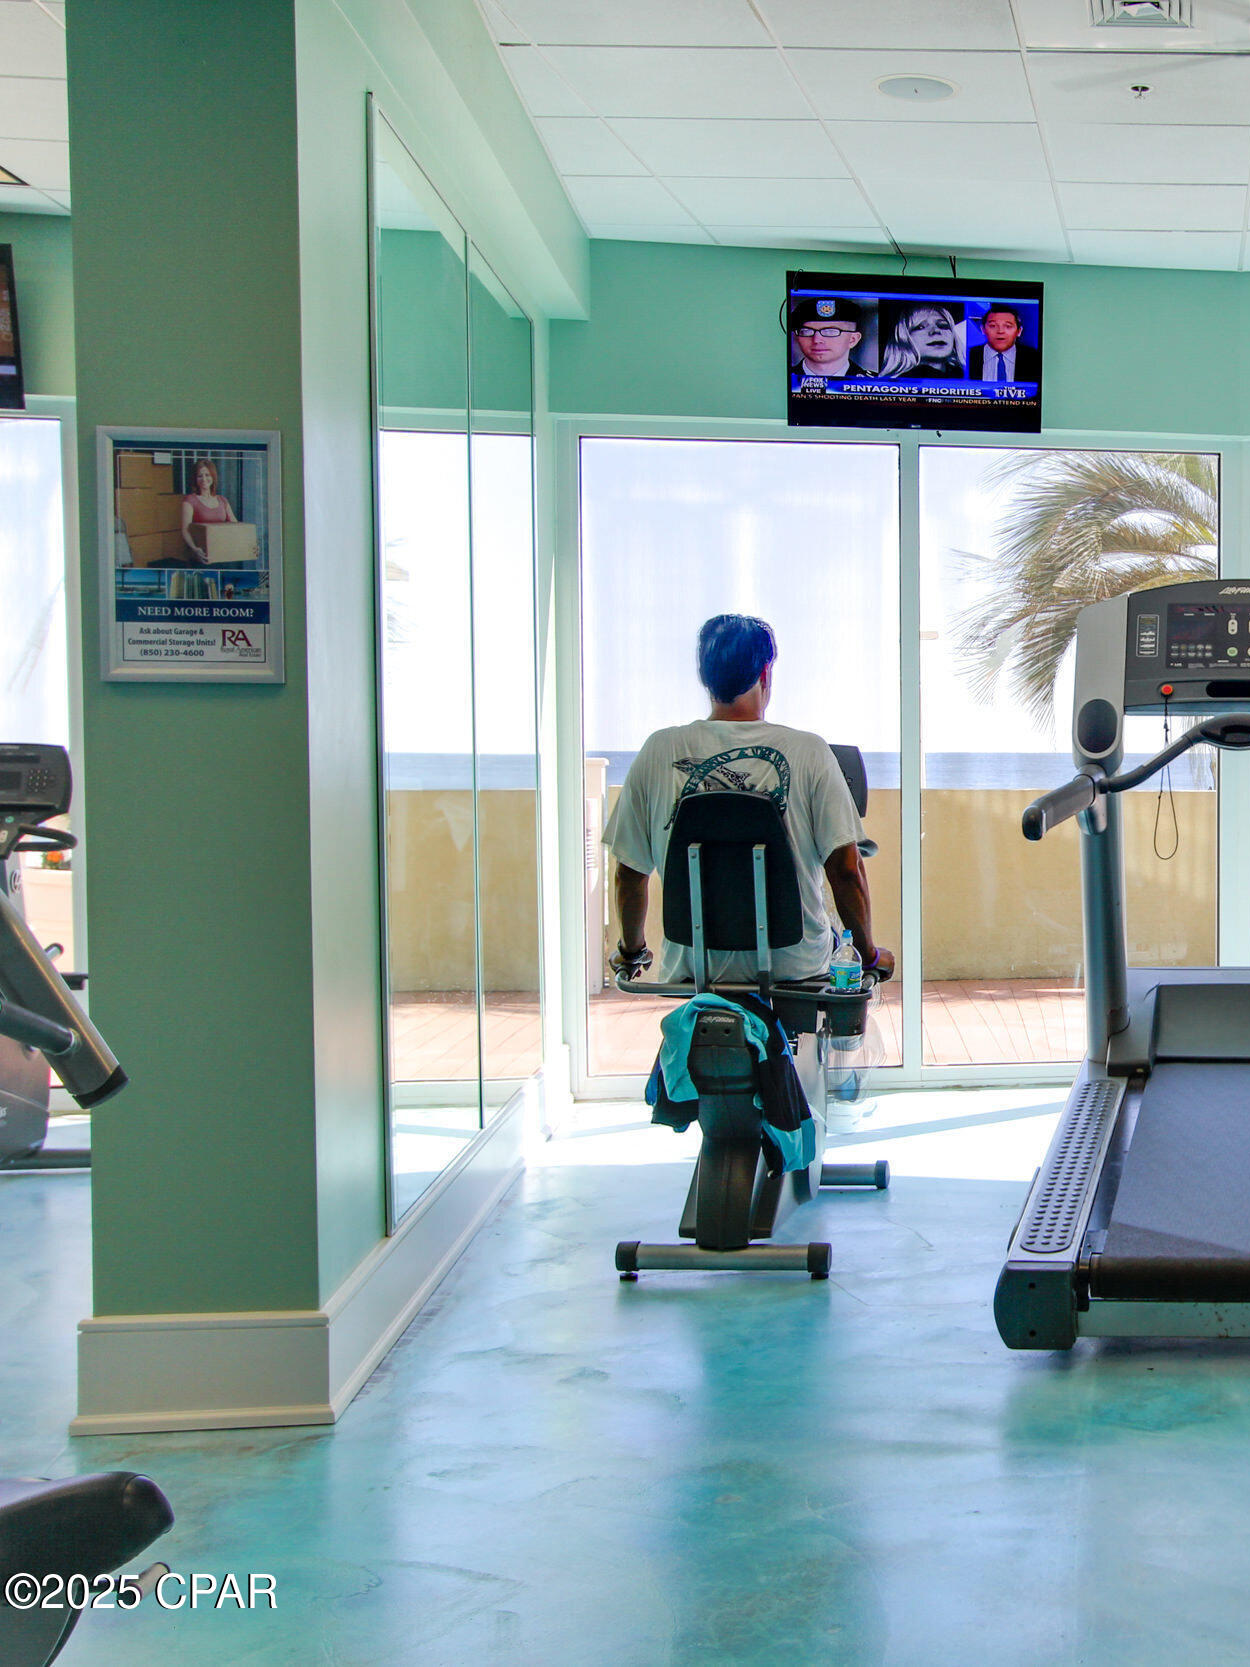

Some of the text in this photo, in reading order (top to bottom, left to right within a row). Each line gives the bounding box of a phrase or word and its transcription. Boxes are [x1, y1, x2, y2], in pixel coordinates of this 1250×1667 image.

[843, 384, 982, 396] PENTAGON'S PRIORITIES
[993, 388, 1026, 398] FIVE
[137, 606, 254, 618] NEED MORE ROOM?
[139, 627, 151, 635] Ask
[152, 627, 173, 635] about
[173, 628, 198, 637] Garage
[127, 638, 216, 647] Commercial Storage Units!
[221, 629, 252, 647] RA
[140, 649, 205, 657] (850) 230-4600
